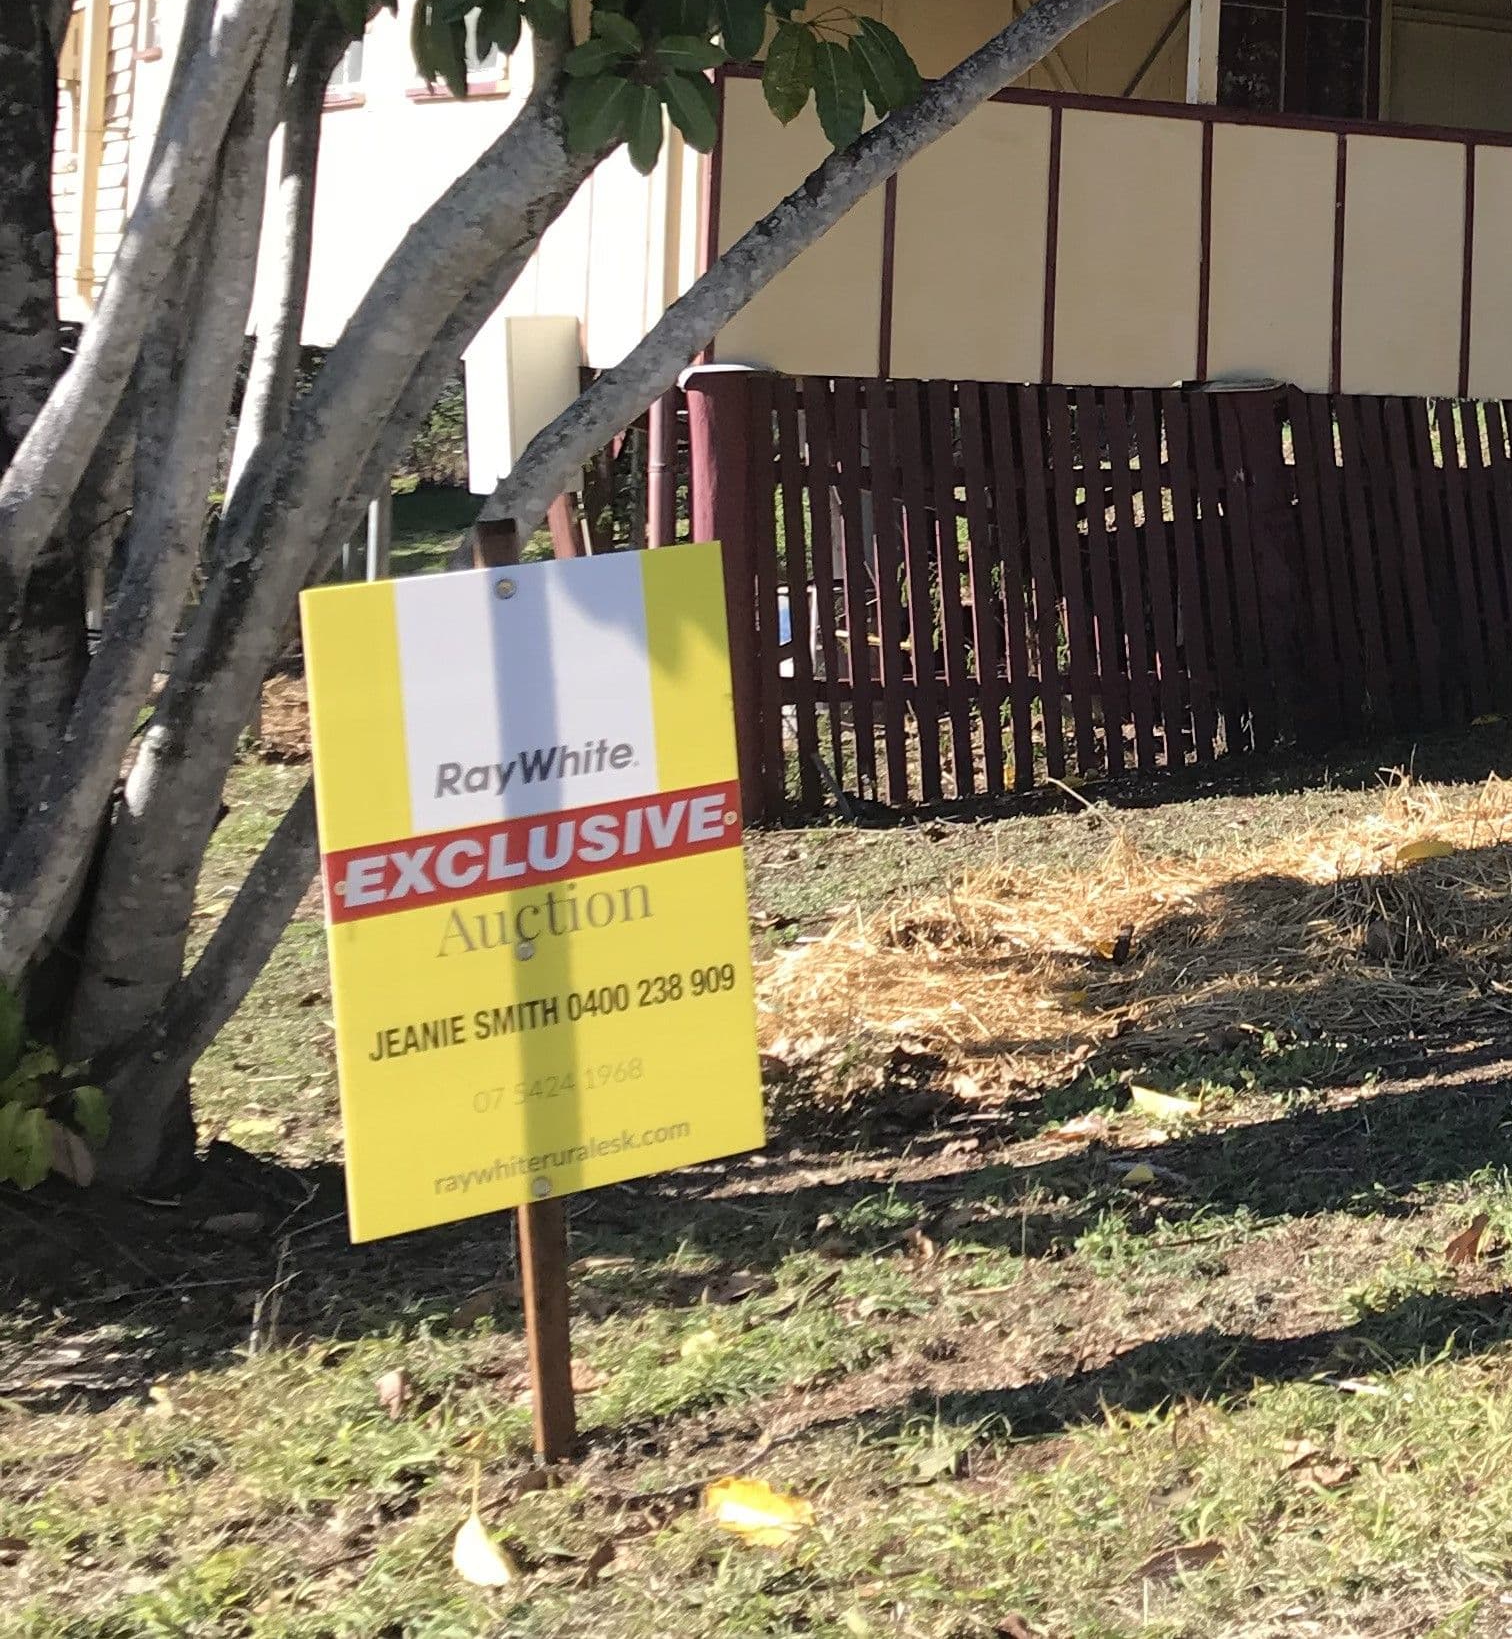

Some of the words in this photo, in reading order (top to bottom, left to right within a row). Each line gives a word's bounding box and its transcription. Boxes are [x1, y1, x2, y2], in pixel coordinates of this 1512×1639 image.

[344, 792, 728, 908] EXCLUSIVE
[436, 881, 655, 958] Auction
[368, 1014, 466, 1062] JEANIE
[473, 996, 559, 1042] SMITH
[567, 982, 629, 1023] 0400
[637, 974, 684, 1008] 238
[690, 963, 735, 997] 909
[472, 1087, 504, 1114] 07
[511, 1071, 577, 1106] 5424
[585, 1057, 644, 1092] 1968
[433, 1121, 691, 1194] raywhiteruralesk.com
